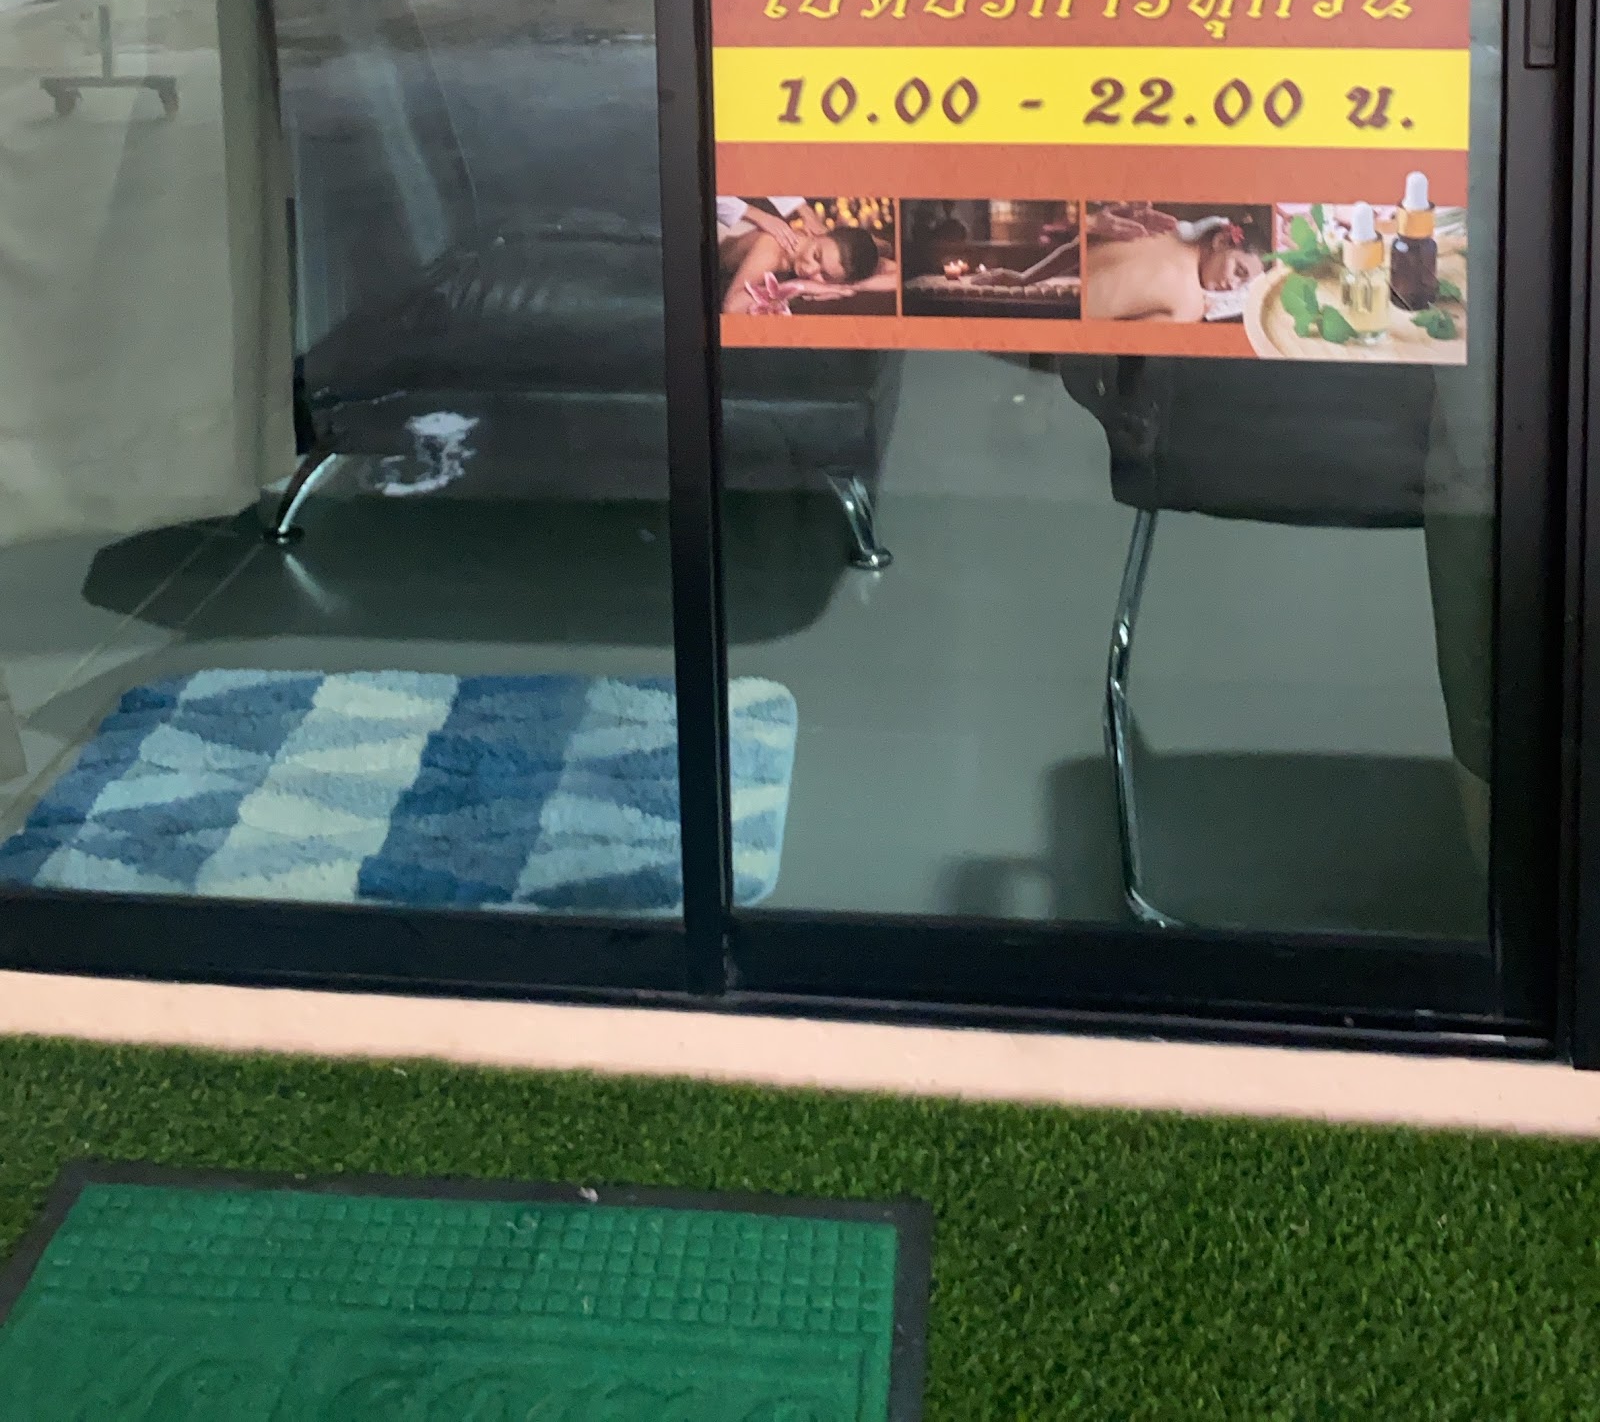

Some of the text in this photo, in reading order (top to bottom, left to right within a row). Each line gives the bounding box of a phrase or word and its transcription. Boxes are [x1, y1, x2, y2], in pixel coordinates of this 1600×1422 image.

[778, 76, 979, 125] 10.00
[1083, 77, 1303, 129] 22.00
[1344, 85, 1415, 129] น.
